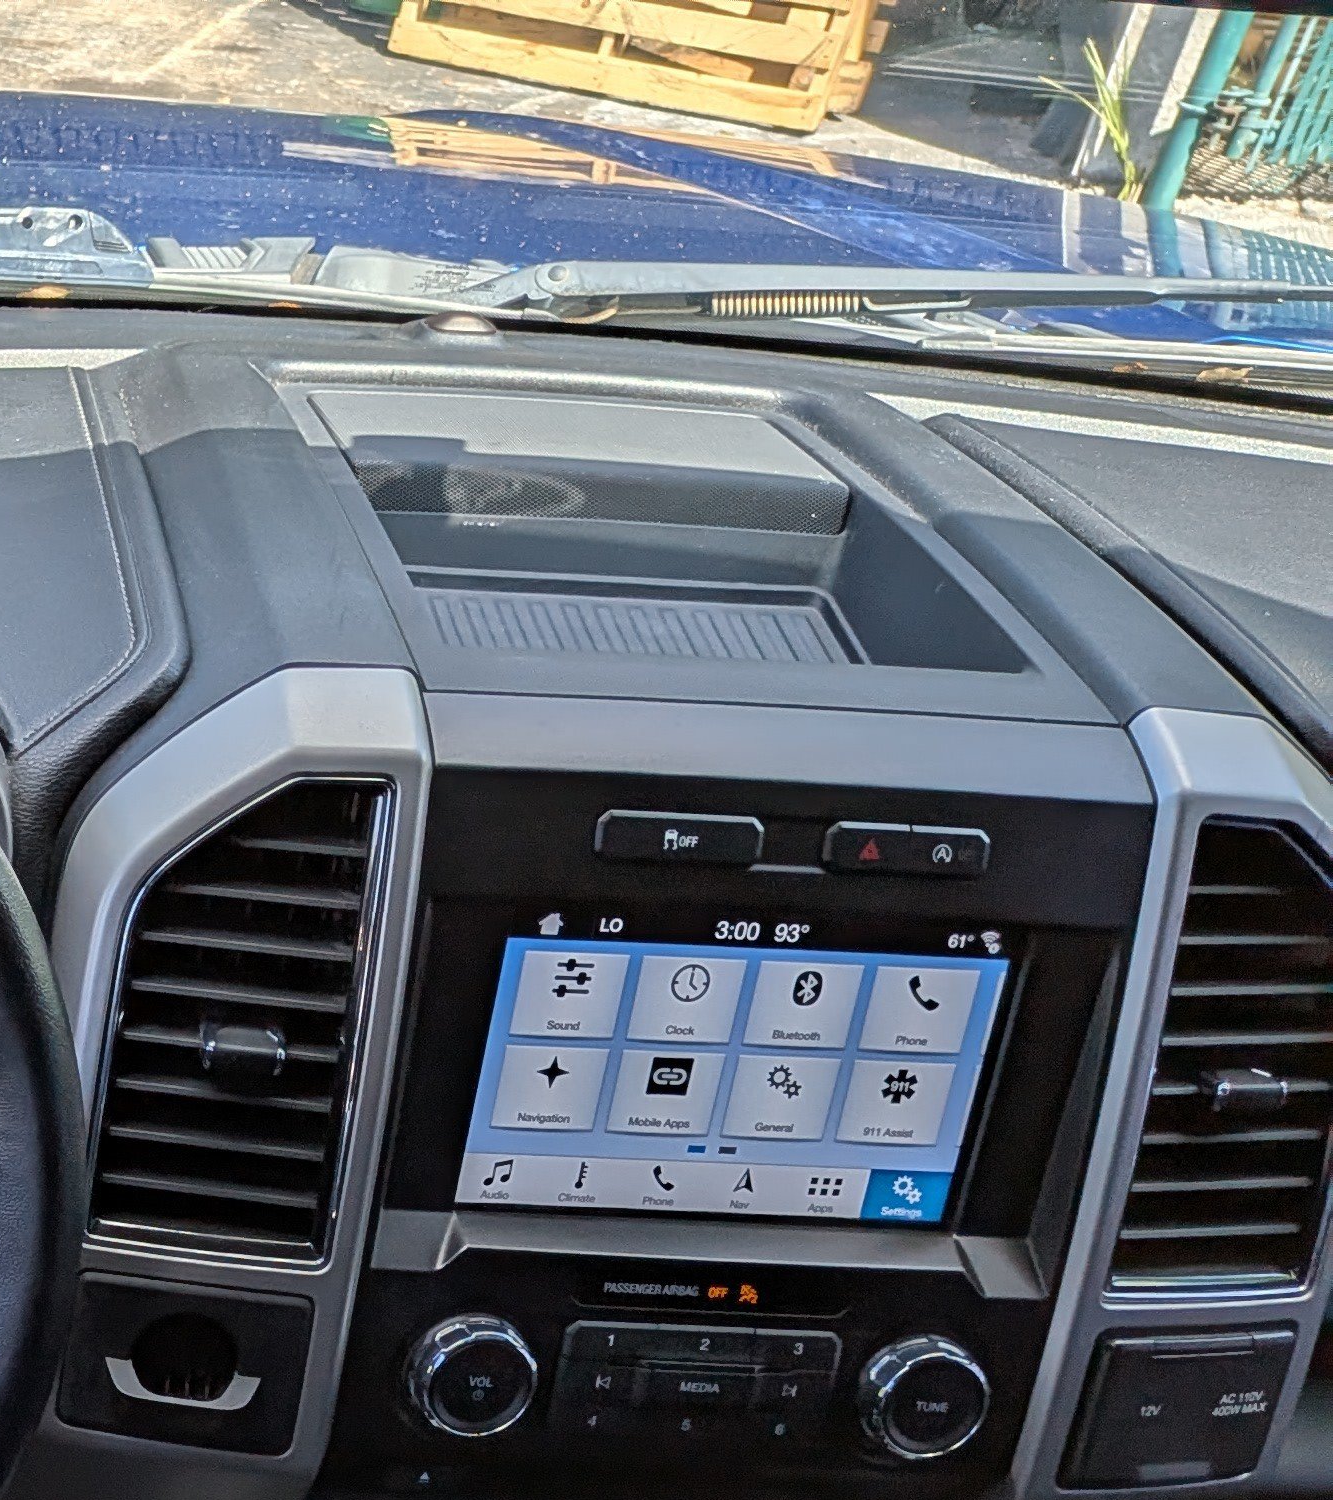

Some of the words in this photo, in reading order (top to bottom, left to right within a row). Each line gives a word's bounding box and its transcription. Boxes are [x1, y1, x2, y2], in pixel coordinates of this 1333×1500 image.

[678, 834, 699, 848] OFF
[599, 917, 624, 933] LO
[715, 921, 761, 941] 3:00
[546, 1019, 581, 1032] Sound
[665, 1024, 695, 1037] Clock
[771, 1028, 821, 1043] Bluetooth
[895, 1034, 928, 1048] Phone
[890, 1079, 911, 1093] 911
[517, 1112, 571, 1125] Navigation
[628, 1116, 661, 1129] Mobile
[663, 1118, 691, 1130] Apps
[754, 1121, 795, 1134] General
[863, 1126, 881, 1138] 911
[882, 1128, 914, 1139] Assist
[479, 1189, 509, 1200] Audio
[557, 1192, 596, 1204] Climate
[642, 1196, 674, 1207] Phone
[729, 1200, 750, 1210] Nav
[807, 1203, 834, 1215] Apps
[880, 1206, 923, 1219] Settings
[603, 1281, 661, 1296] PASSENGER
[707, 1285, 729, 1299] OFF
[606, 1334, 615, 1347] 1
[699, 1338, 710, 1351] 2
[793, 1342, 804, 1355] 3
[679, 1380, 720, 1394] MEDIA
